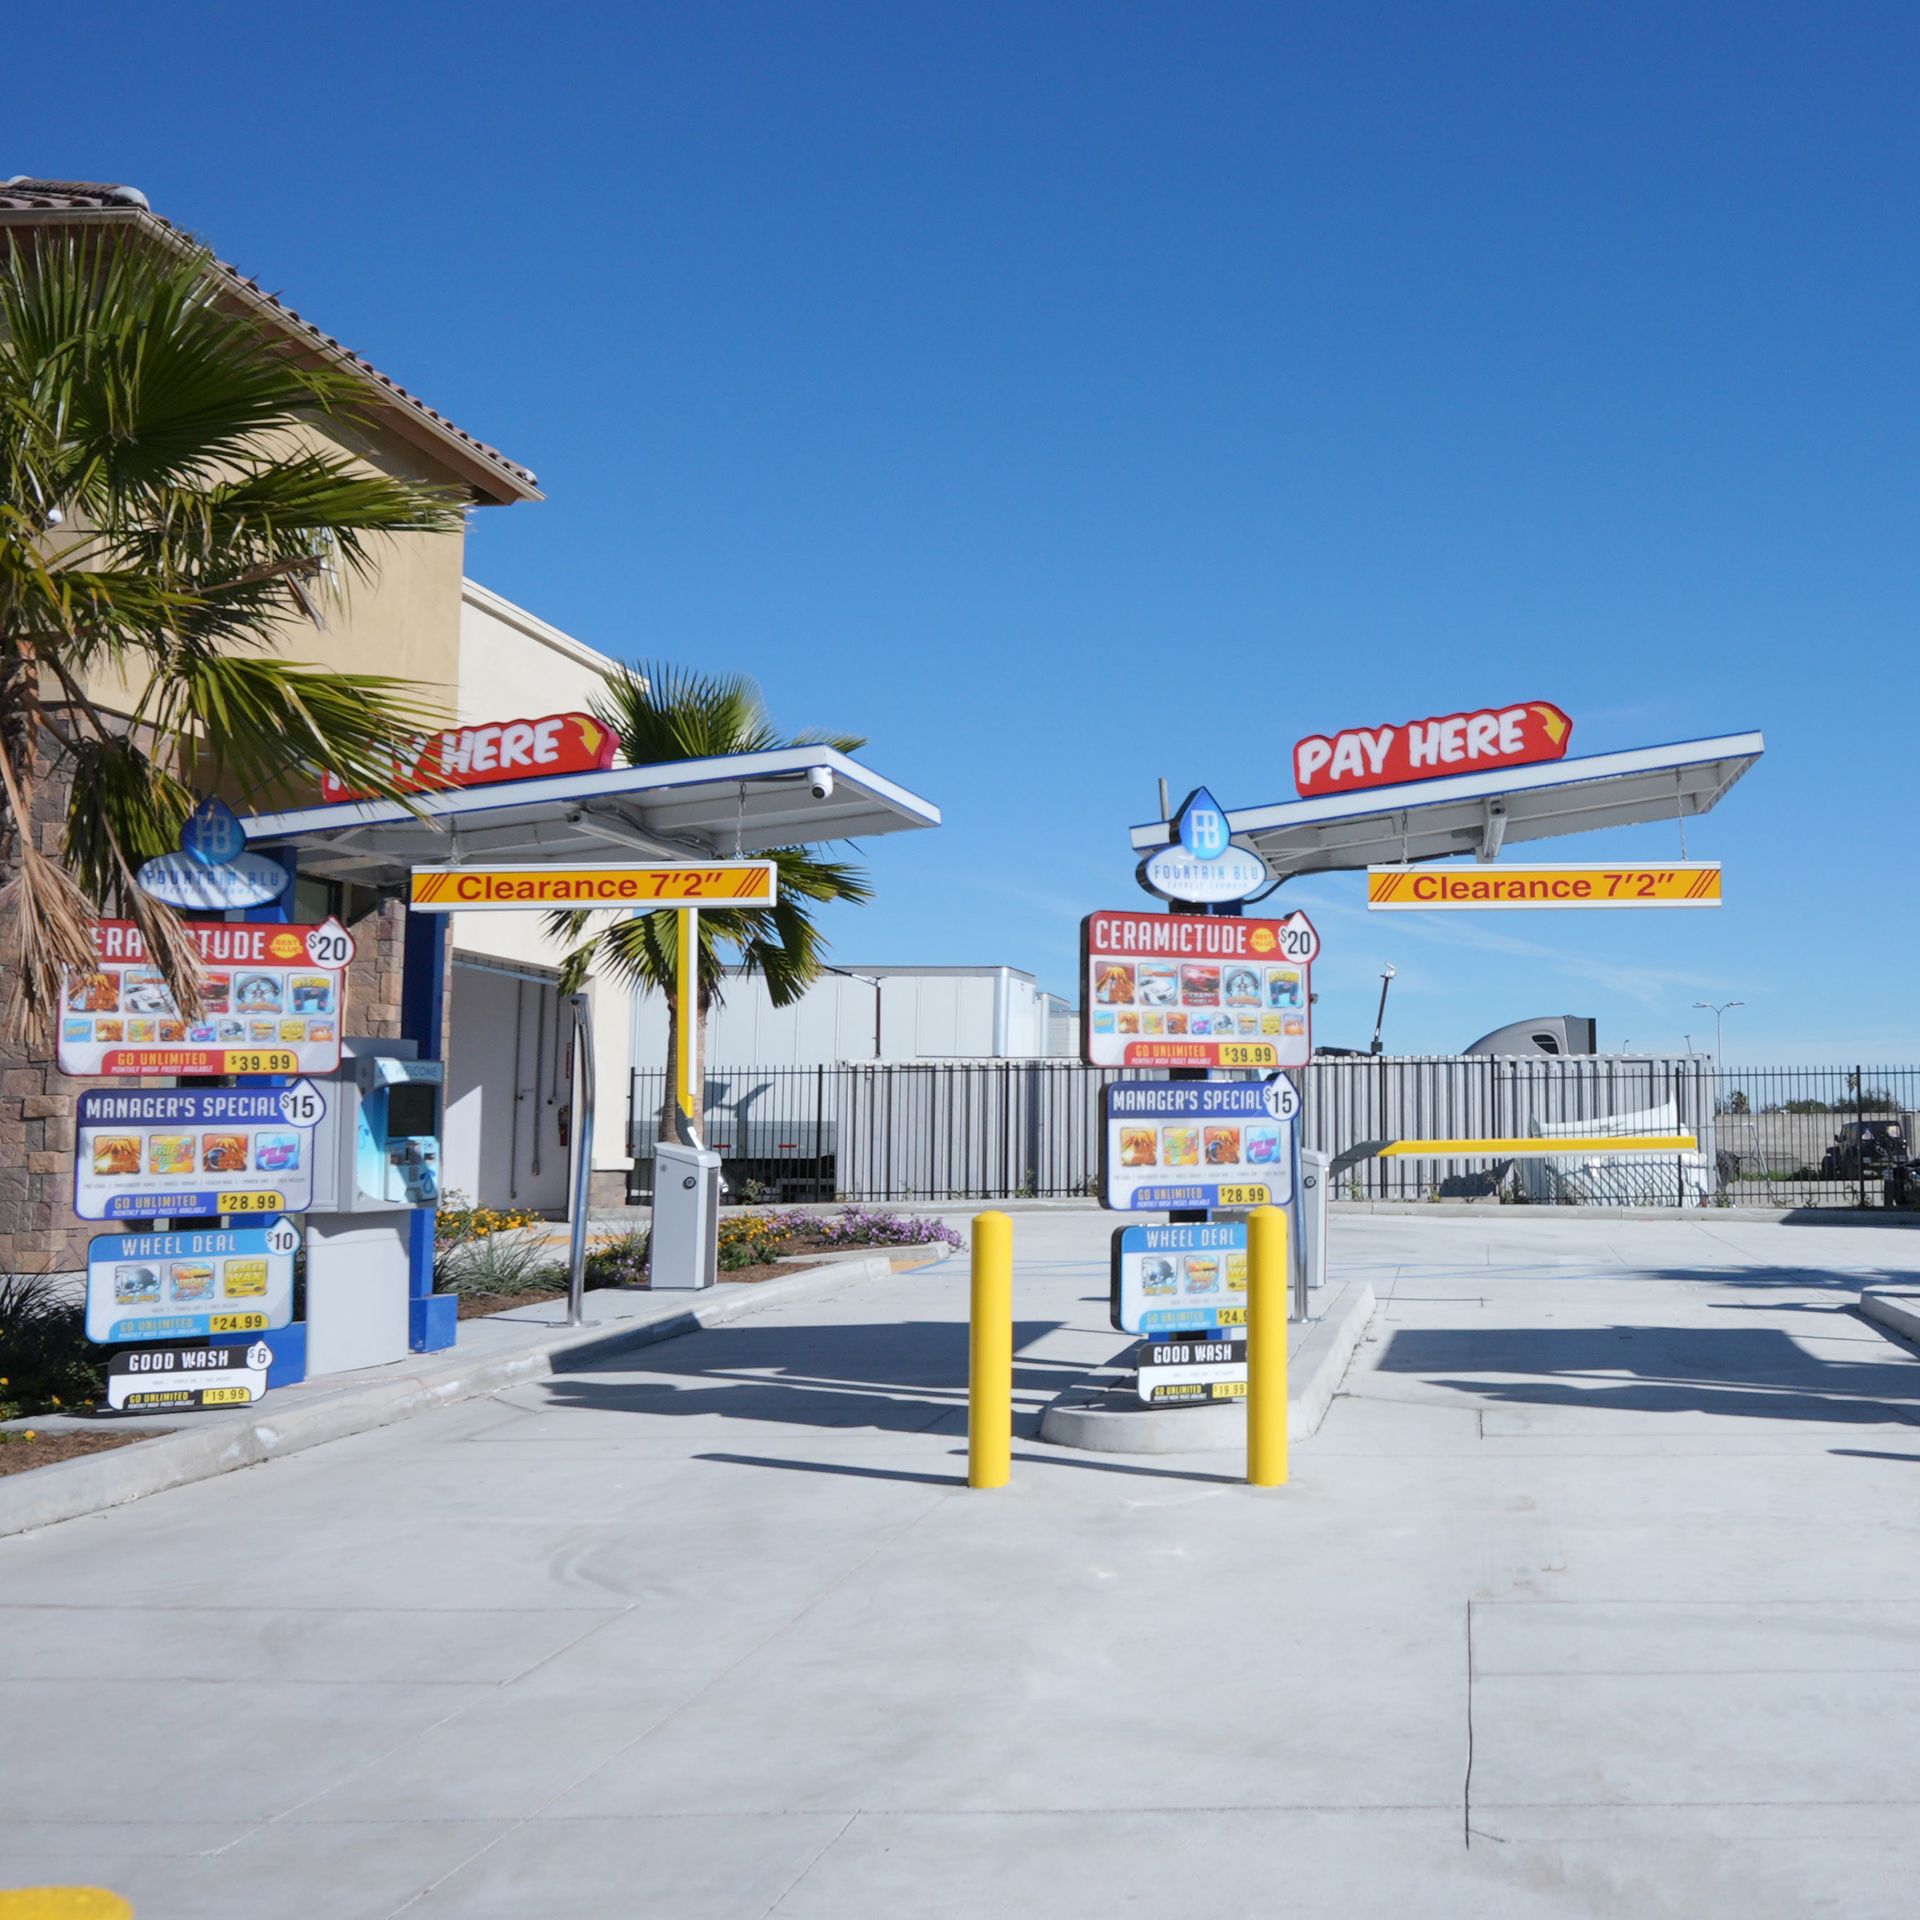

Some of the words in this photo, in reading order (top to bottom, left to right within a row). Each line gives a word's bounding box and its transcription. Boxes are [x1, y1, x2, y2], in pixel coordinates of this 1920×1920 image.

[440, 719, 563, 775] HERE
[1298, 728, 1394, 784] PAY
[1409, 709, 1527, 767] HERE
[1191, 810, 1219, 848] FB
[248, 871, 279, 886] BLU
[1155, 865, 1224, 880] FOUNTAIN
[1234, 866, 1258, 880] BLU
[457, 876, 637, 899] Clearance
[650, 872, 723, 896] 7'2"
[1413, 875, 1592, 899] Clearance
[1603, 873, 1675, 897] 7'2"
[308, 933, 347, 960] $20
[1095, 920, 1247, 954] CERAMICTUDE
[1280, 928, 1310, 954] $20
[117, 1052, 134, 1065] GO
[140, 1052, 207, 1065] UNLIMITED
[1136, 1045, 1149, 1057] GO
[1152, 1045, 1205, 1057] UNLIMITED
[1225, 1047, 1271, 1063] $39.99
[231, 1054, 290, 1071] $39.99
[86, 1097, 196, 1119] MANAGER'S
[203, 1096, 278, 1117] SPECIAL
[281, 1094, 315, 1118] $15
[1113, 1090, 1198, 1111] MANAGER'S
[1203, 1089, 1263, 1110] SPECIAL
[1264, 1087, 1292, 1113] $15
[114, 1197, 130, 1209] GO
[135, 1195, 197, 1208] UNLIMITED
[222, 1195, 276, 1210] $28.99
[1138, 1188, 1150, 1200] GO
[1154, 1187, 1202, 1199] UNLIMITED
[1221, 1188, 1264, 1203] $28.99
[122, 1237, 183, 1257] WHEEL
[193, 1234, 236, 1254] DEAL
[267, 1231, 293, 1250] $10
[1147, 1230, 1194, 1248] WHEEL
[1201, 1228, 1235, 1247] DEAL
[214, 1314, 262, 1330] $24.99
[129, 1352, 174, 1372] GOOD
[182, 1350, 229, 1369] WASH
[249, 1348, 267, 1364] $6
[1153, 1345, 1190, 1364] GOOD
[1194, 1343, 1232, 1362] WASH
[130, 1394, 140, 1404] GO
[144, 1391, 189, 1403] UNLIMITED
[205, 1389, 245, 1401] $19.99
